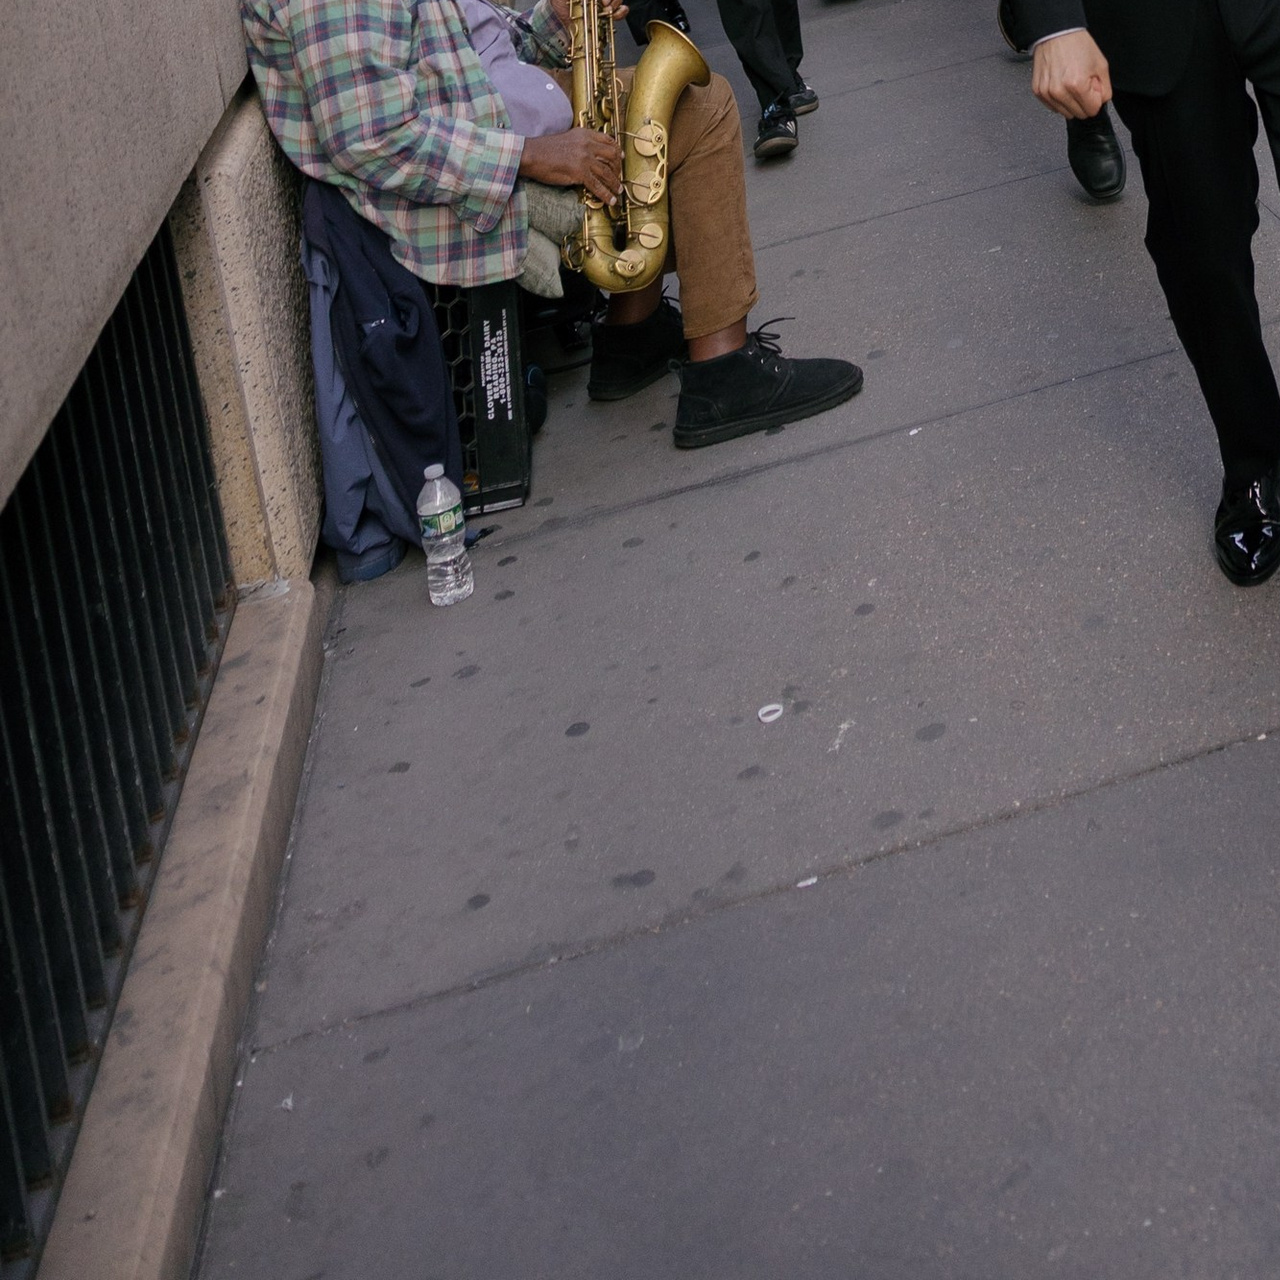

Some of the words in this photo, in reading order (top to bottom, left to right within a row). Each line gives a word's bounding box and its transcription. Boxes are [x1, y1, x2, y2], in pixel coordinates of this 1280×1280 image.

[490, 337, 497, 351] PA
[496, 329, 507, 404] 1-800-323-0123
[486, 383, 495, 420] CLOVER
